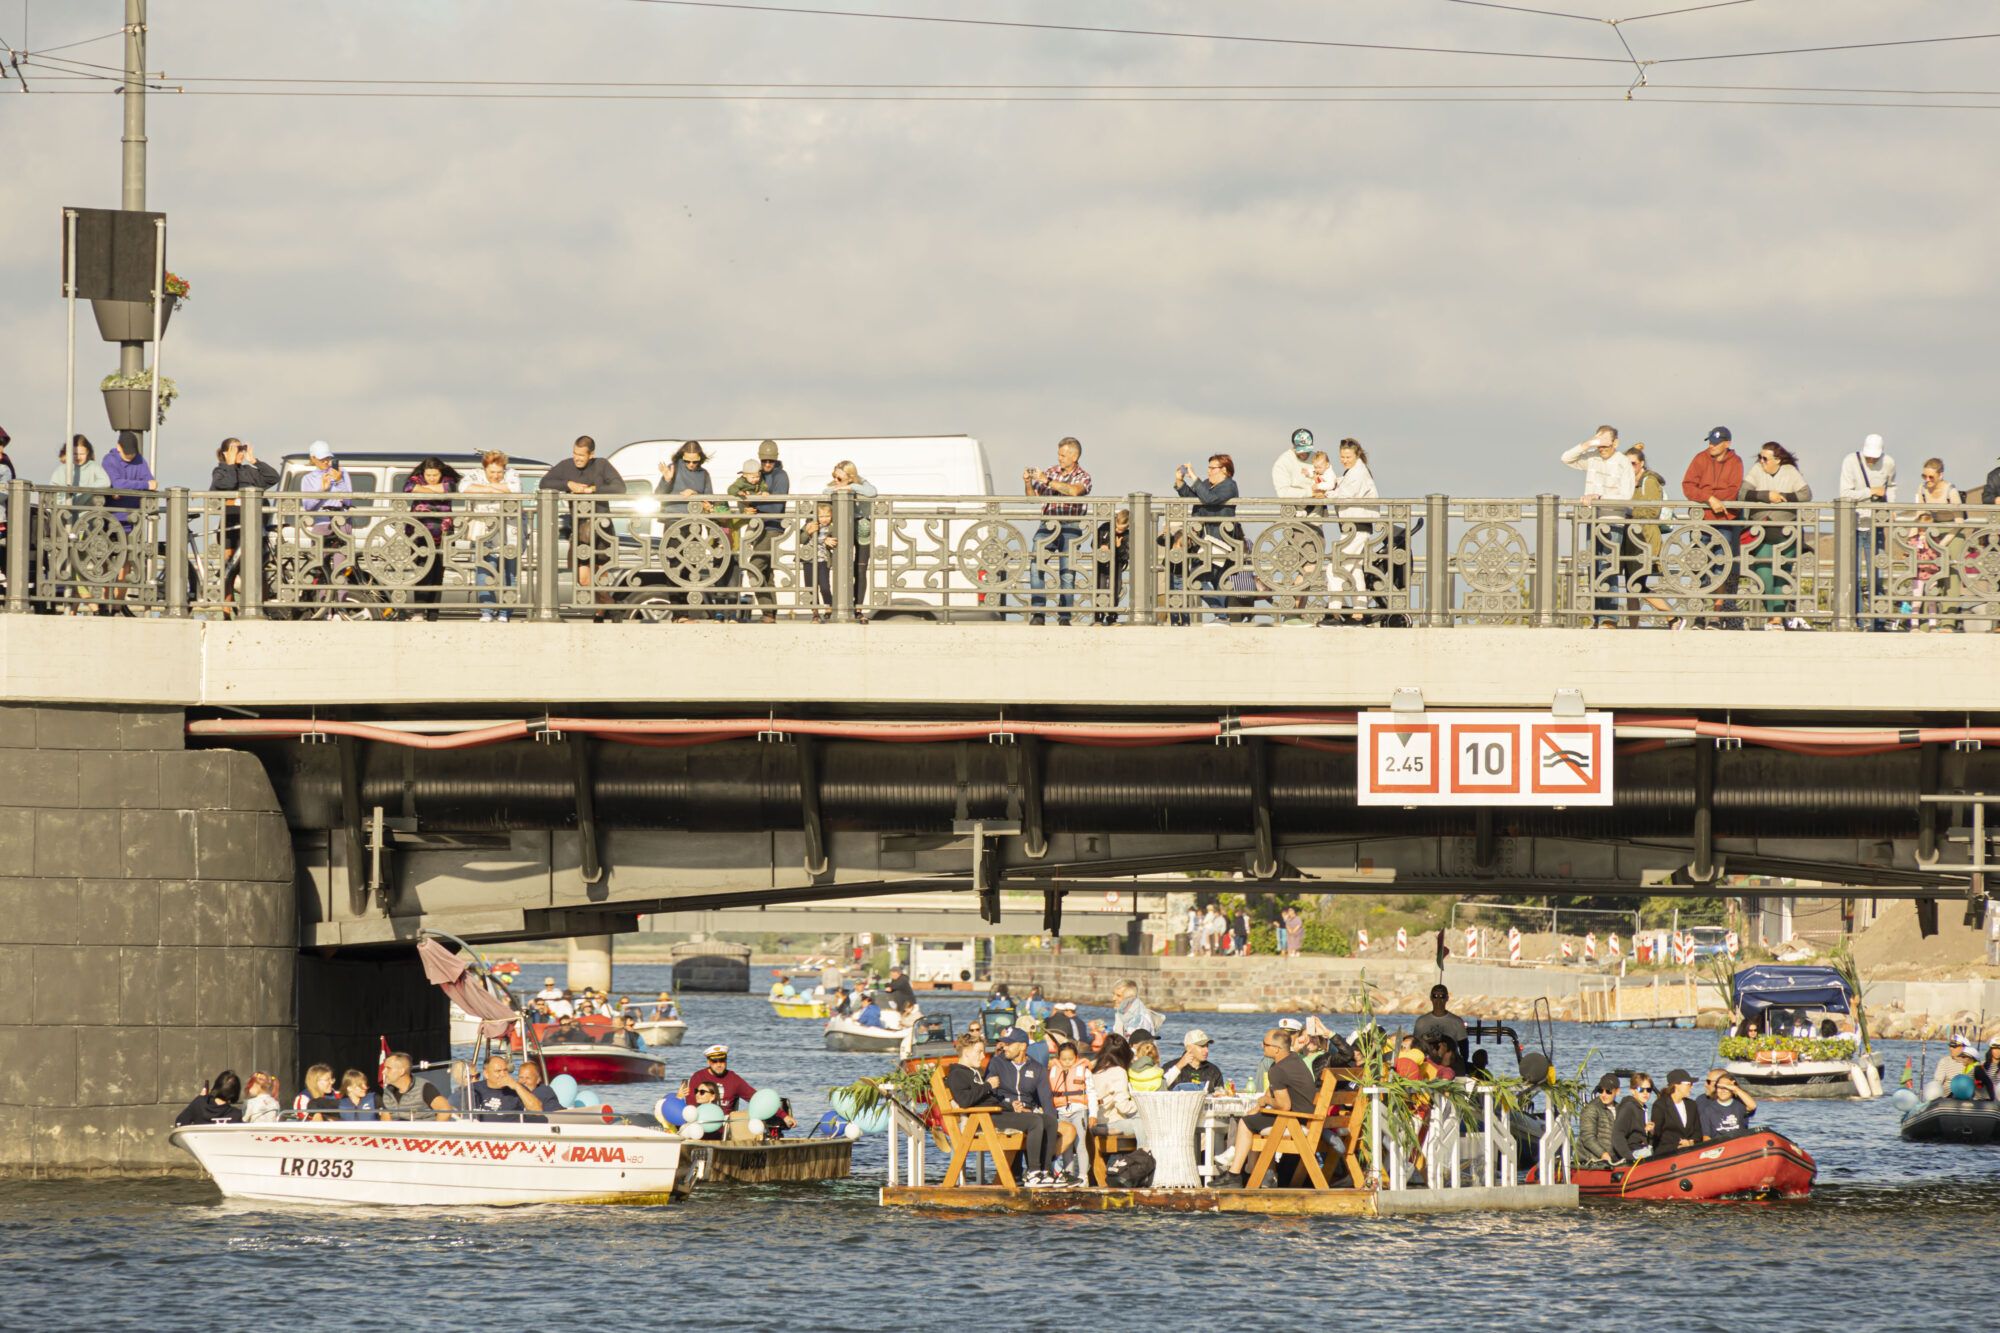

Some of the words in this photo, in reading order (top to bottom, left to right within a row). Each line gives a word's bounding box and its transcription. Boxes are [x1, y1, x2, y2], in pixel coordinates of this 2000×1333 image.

[1385, 756, 1424, 772] 2.45
[1465, 742, 1505, 775] 10
[570, 1146, 626, 1163] RANA
[280, 1157, 305, 1176] LR
[307, 1158, 354, 1179] 0353
